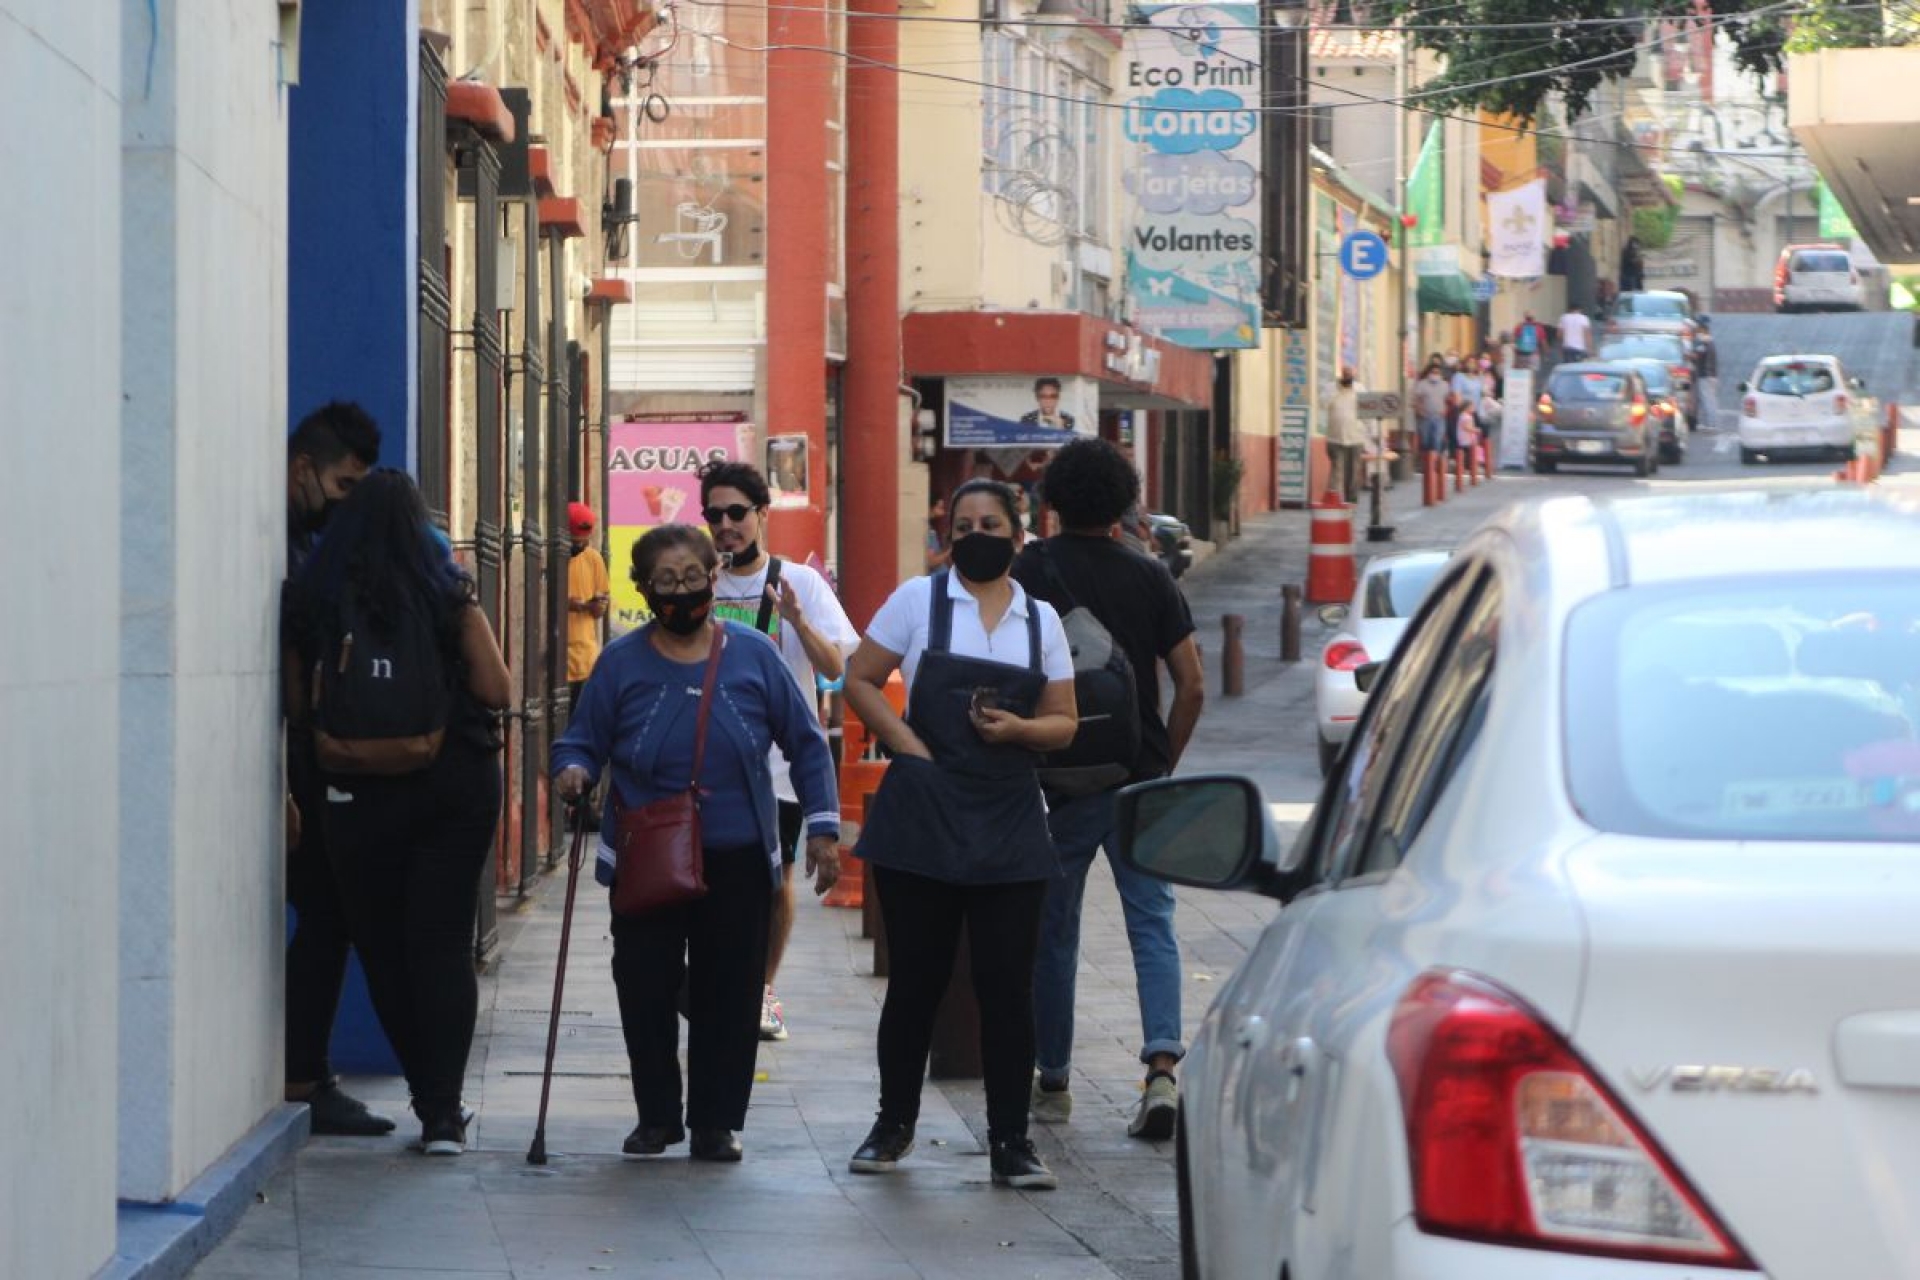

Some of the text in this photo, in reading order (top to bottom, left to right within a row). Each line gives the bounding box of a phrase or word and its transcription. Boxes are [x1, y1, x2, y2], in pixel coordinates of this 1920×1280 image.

[1129, 60, 1254, 87] Eco Print
[1128, 103, 1253, 136] Lonas
[1134, 166, 1252, 203] Tarjetas
[1134, 226, 1254, 252] Volantes
[1352, 240, 1375, 270] E
[610, 447, 727, 472] AGUAS
[372, 658, 392, 678] n
[1626, 1064, 1819, 1094] VERSA
